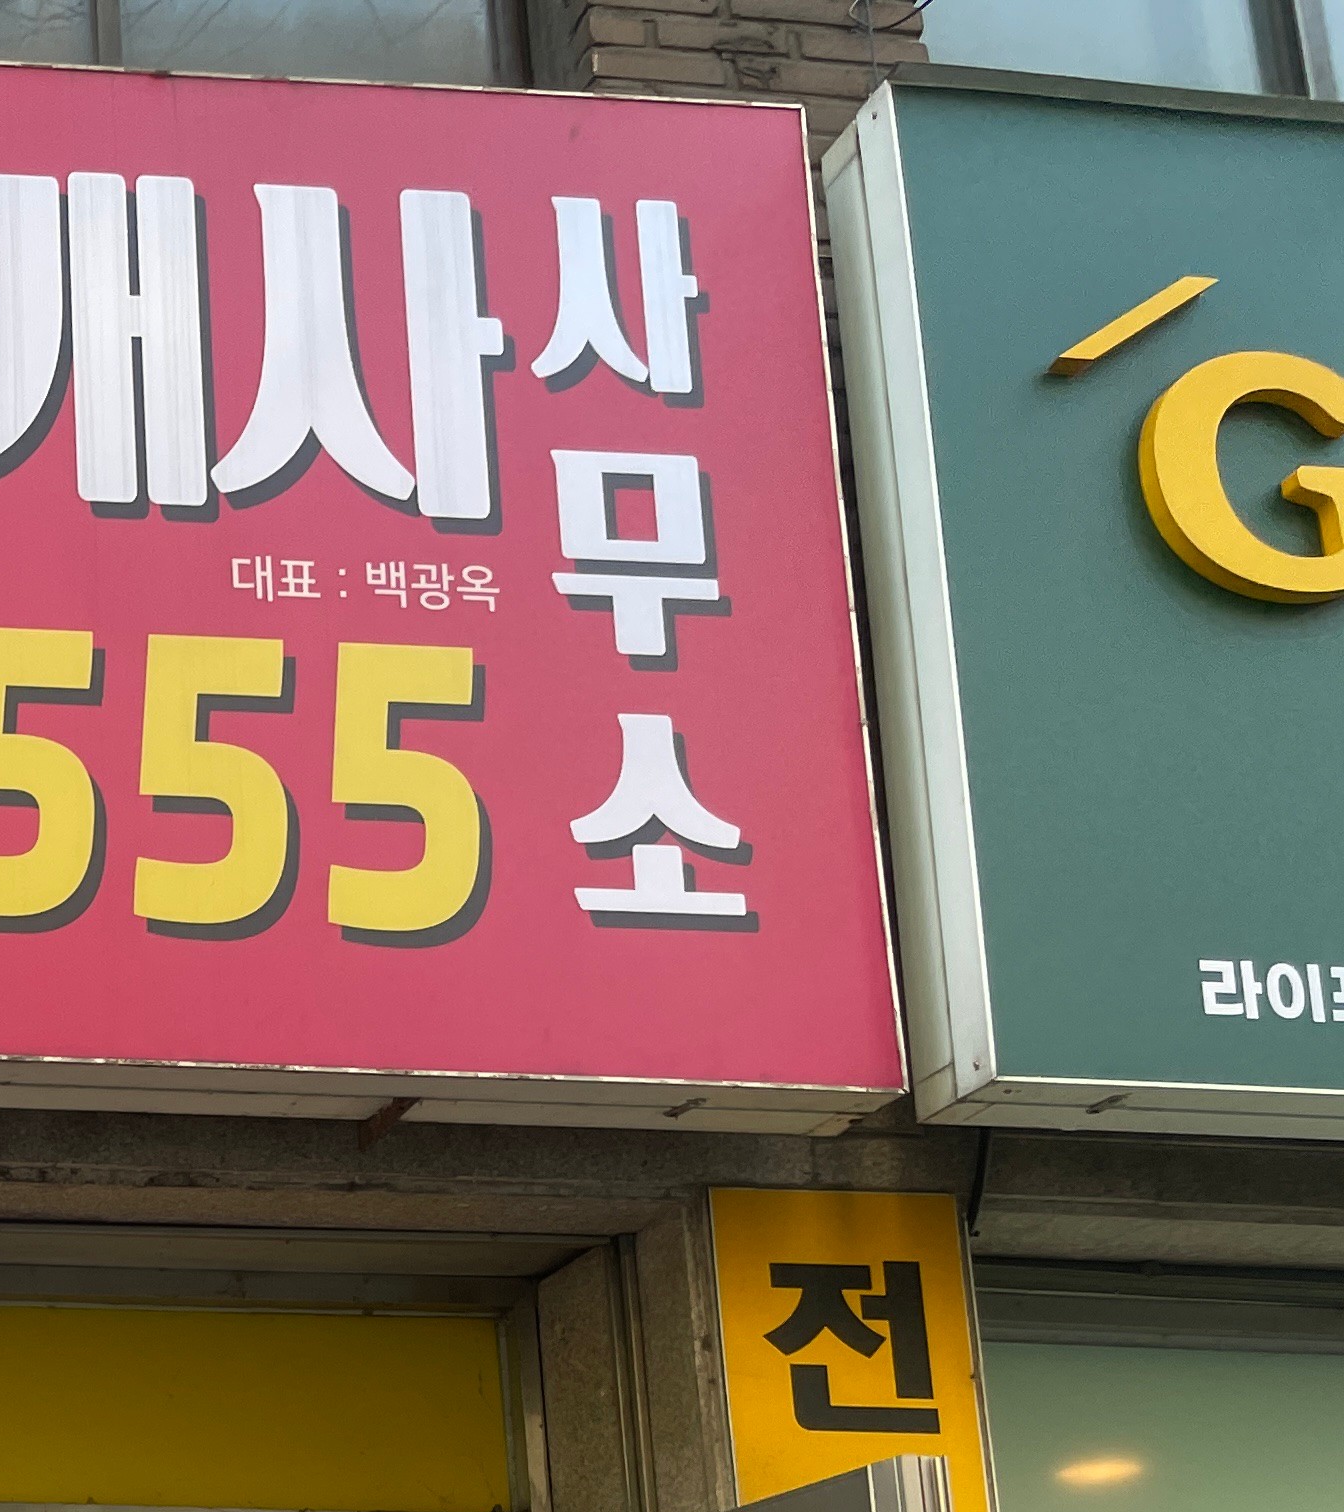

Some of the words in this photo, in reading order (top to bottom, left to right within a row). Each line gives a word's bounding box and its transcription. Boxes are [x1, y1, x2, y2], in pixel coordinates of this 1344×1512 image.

[231, 555, 321, 602] 대표
[365, 561, 500, 612] 백광옥
[532, 195, 746, 918] 사무소
[1199, 959, 1344, 1023] 라이
[764, 1260, 940, 1434] 전
